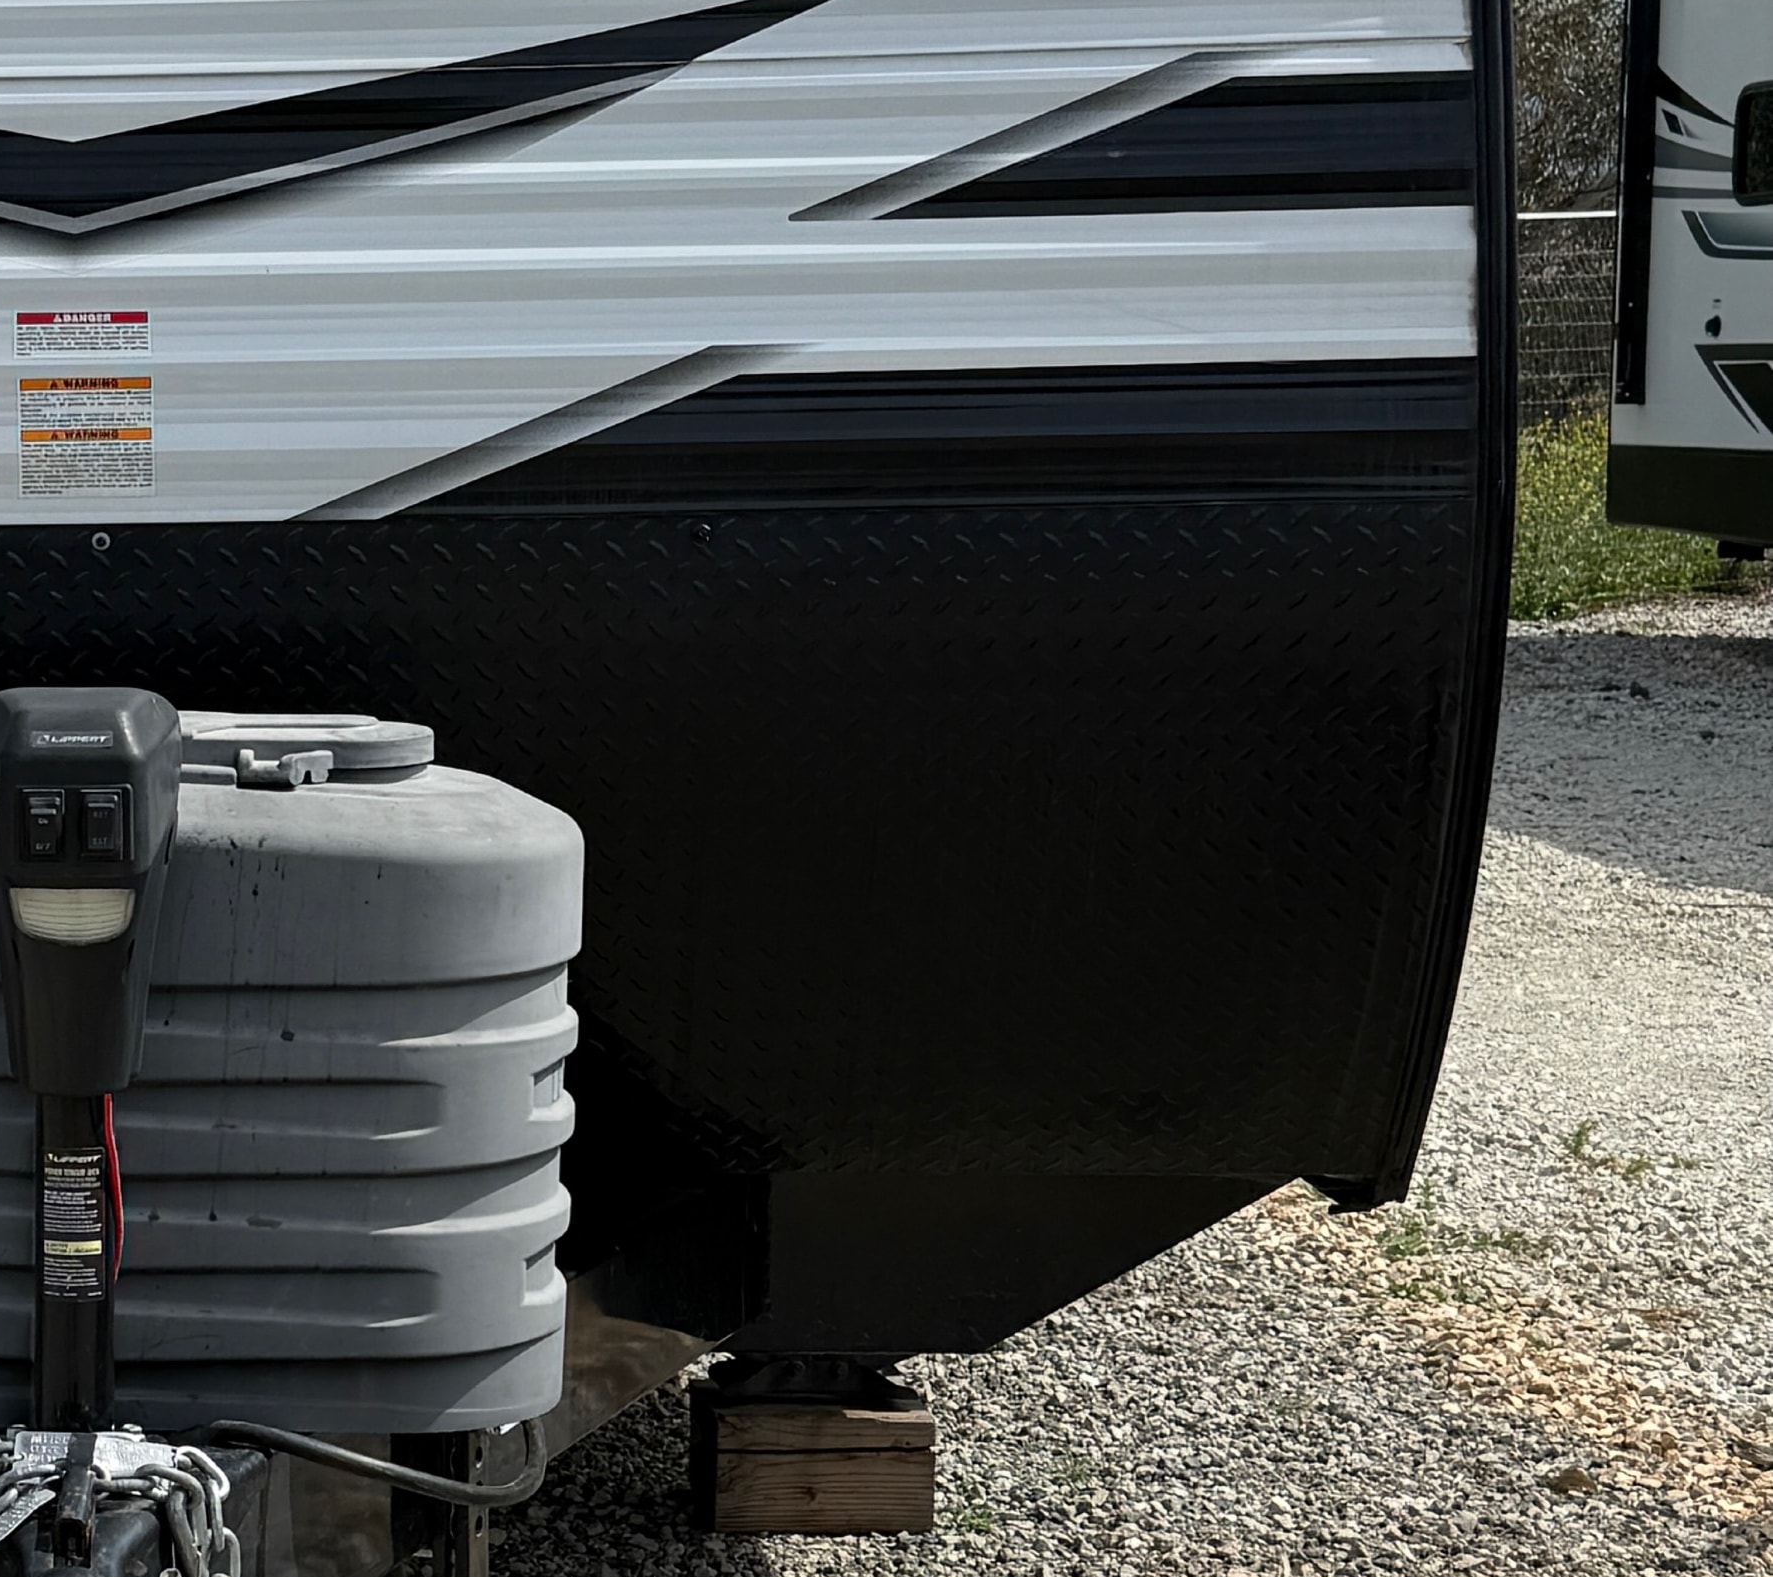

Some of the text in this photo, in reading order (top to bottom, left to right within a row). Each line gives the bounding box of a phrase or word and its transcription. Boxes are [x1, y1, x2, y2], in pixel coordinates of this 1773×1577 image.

[62, 313, 112, 323] DANGER
[63, 378, 119, 390] WARNING
[64, 429, 119, 441] WARNING
[51, 735, 110, 743] LIPPERT
